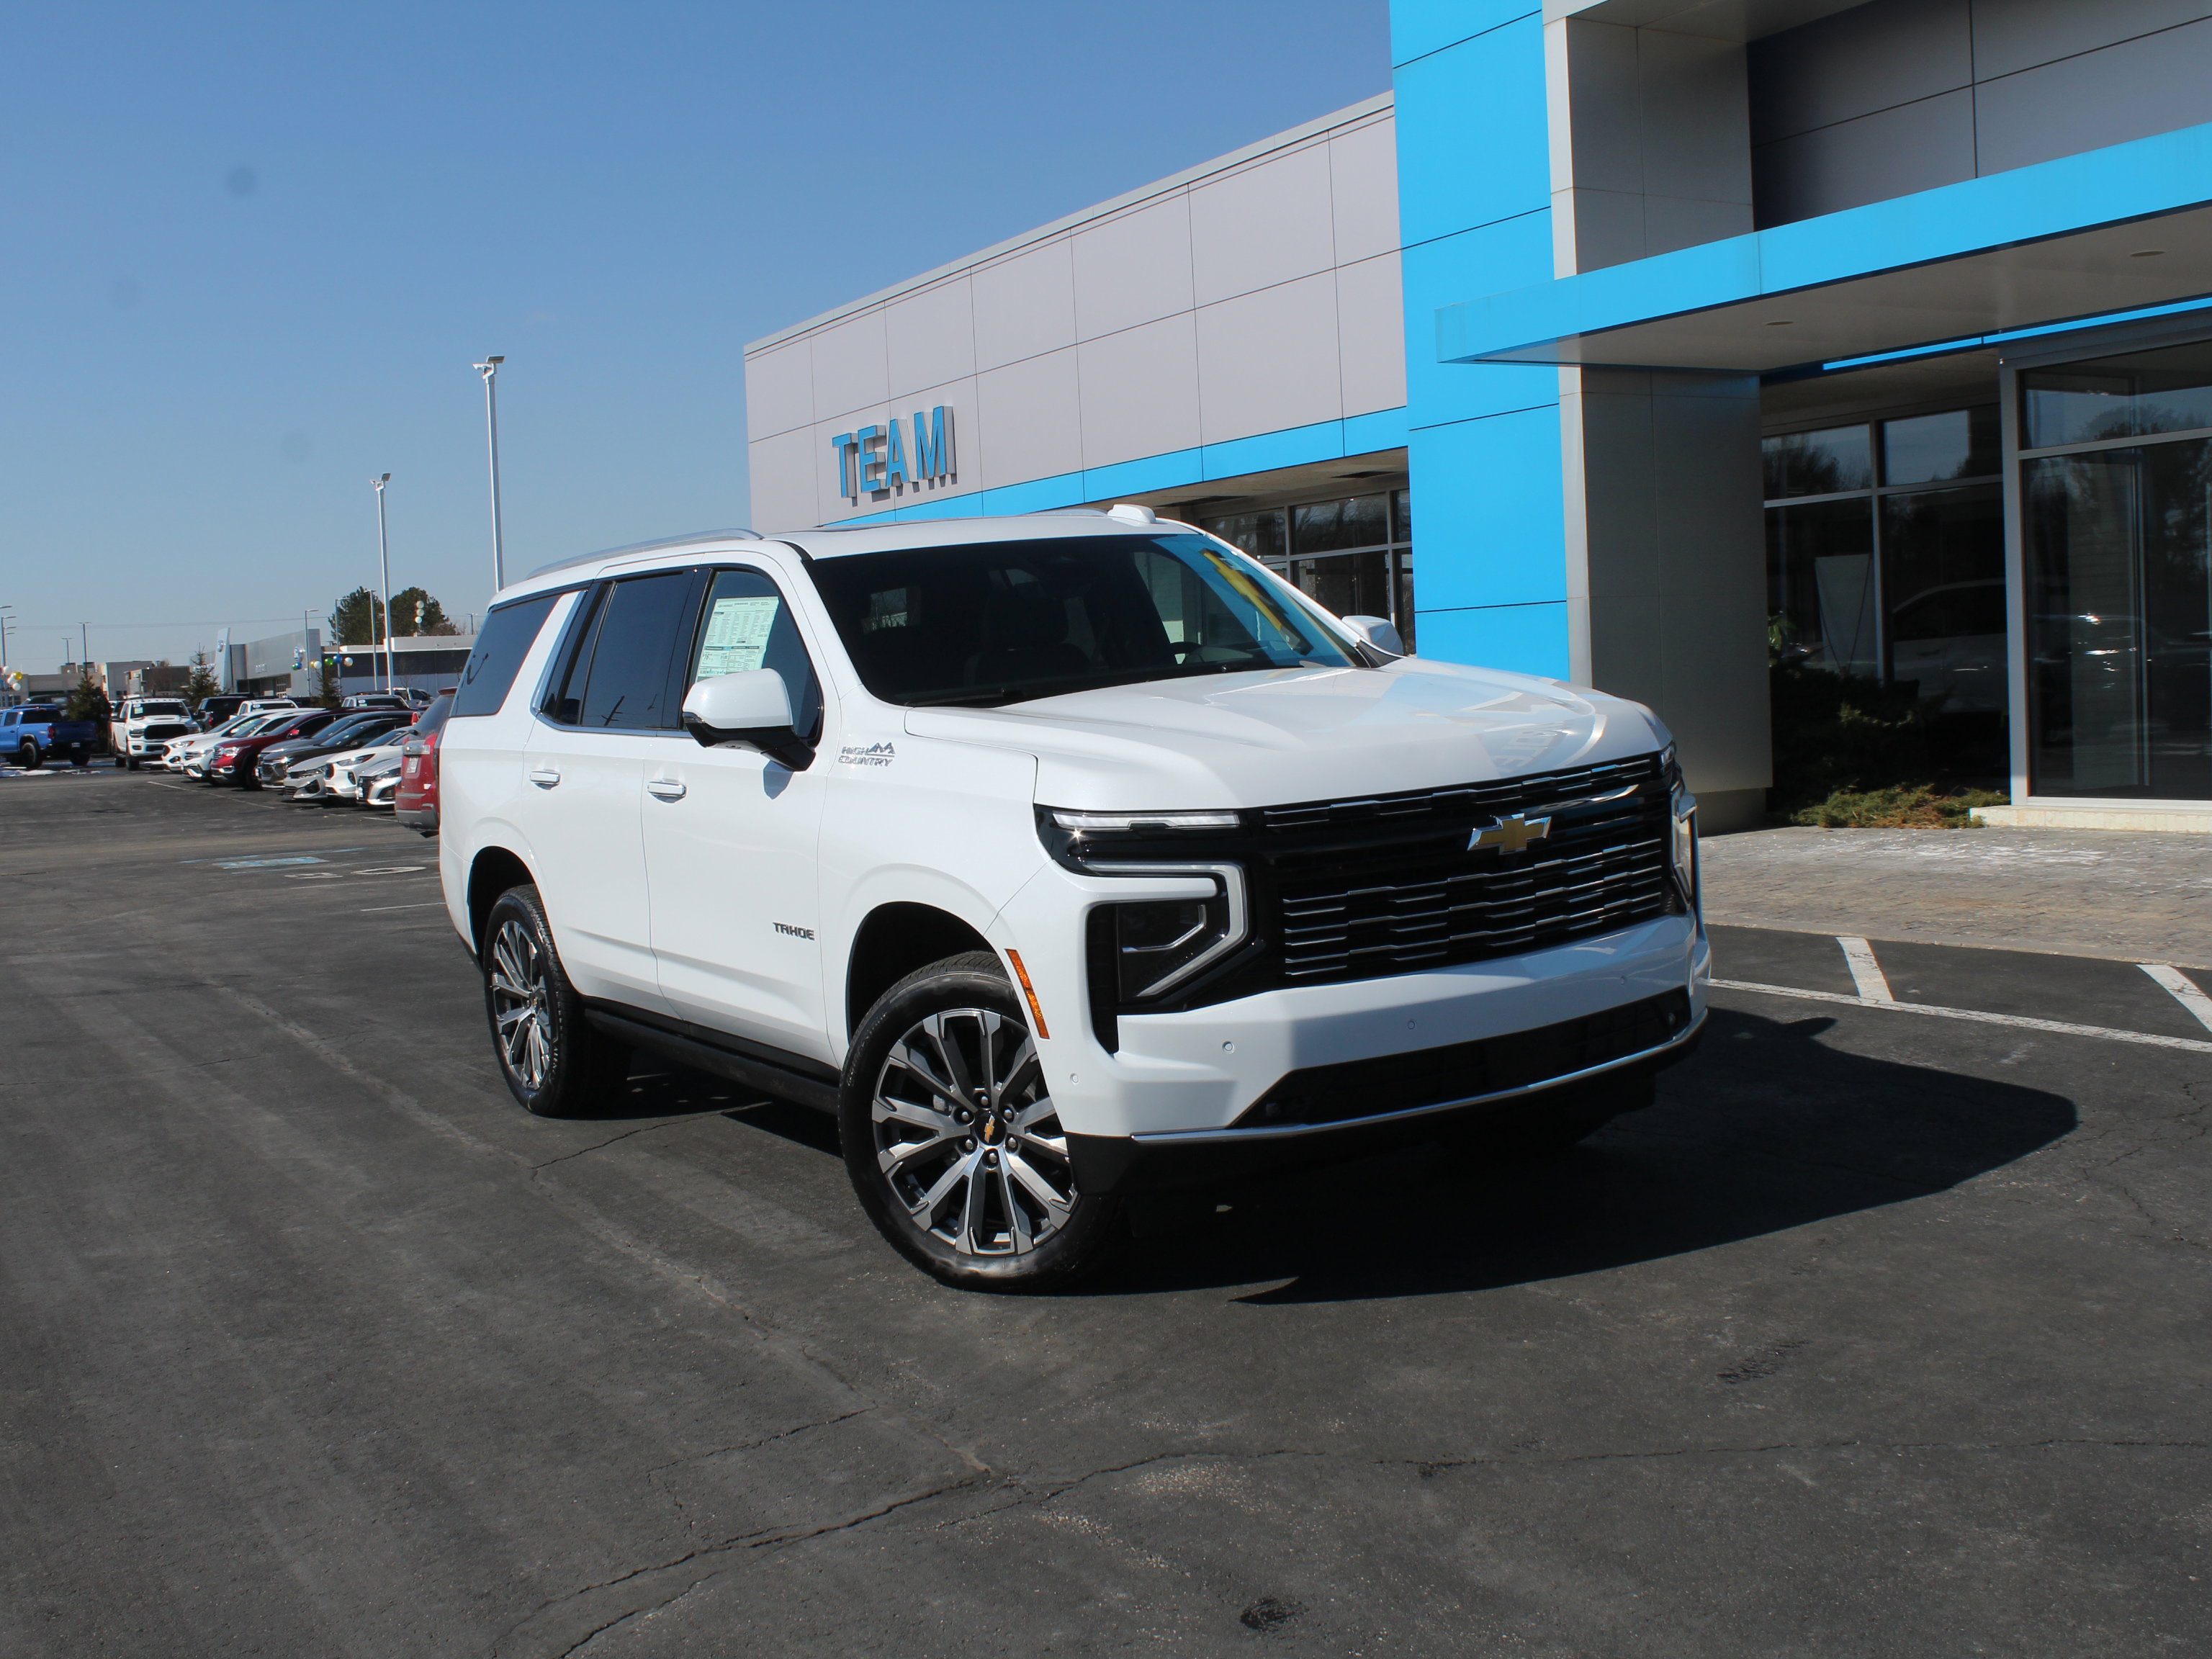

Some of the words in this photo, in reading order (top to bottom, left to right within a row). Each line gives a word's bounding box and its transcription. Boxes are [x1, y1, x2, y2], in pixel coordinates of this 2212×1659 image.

[832, 406, 956, 498] TEAM
[841, 746, 869, 755] HIGH
[838, 755, 893, 767] COUNTRY
[773, 922, 815, 940] TAHOE
